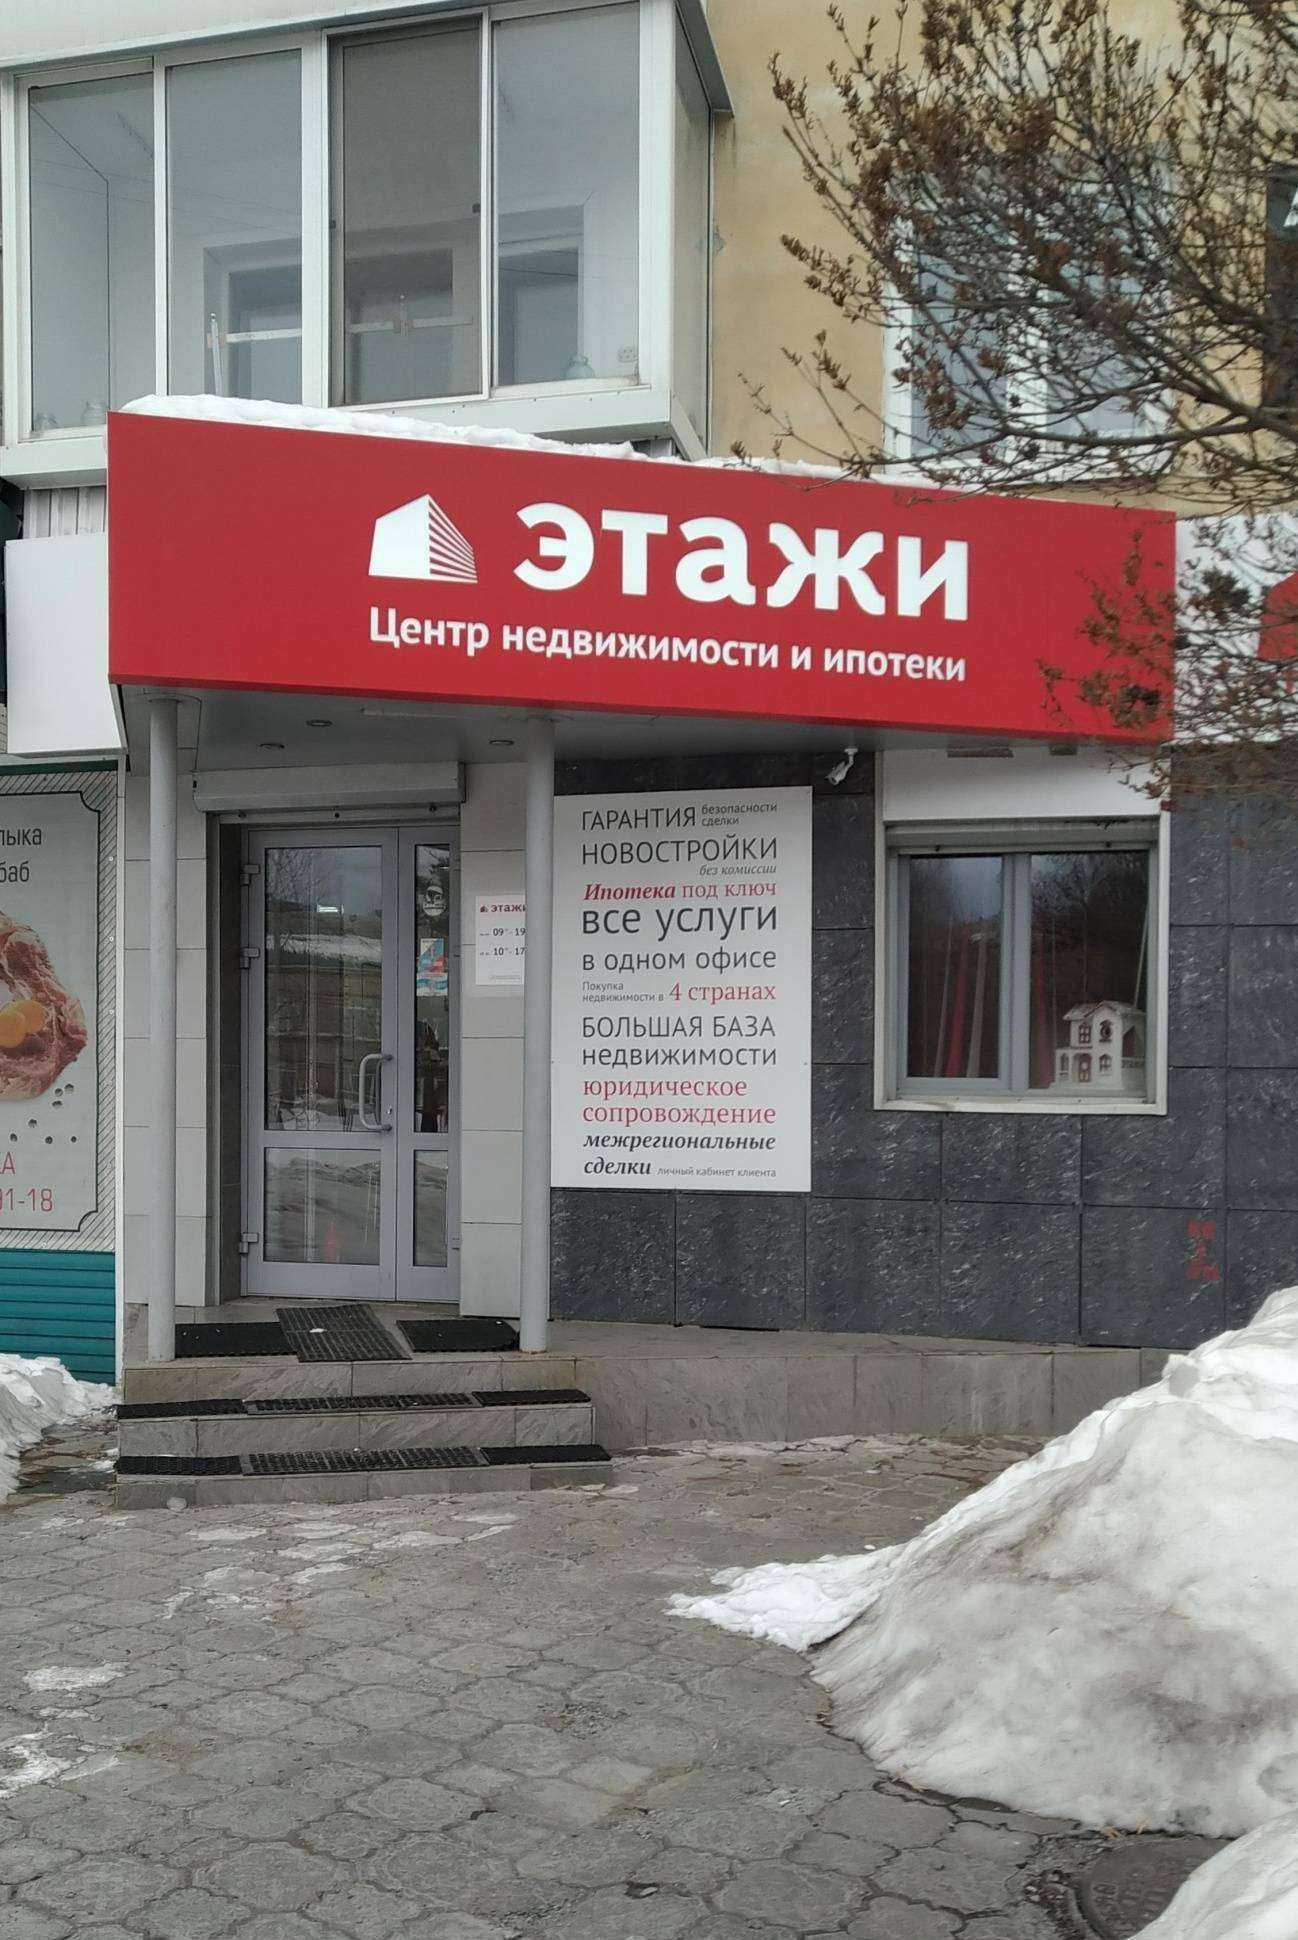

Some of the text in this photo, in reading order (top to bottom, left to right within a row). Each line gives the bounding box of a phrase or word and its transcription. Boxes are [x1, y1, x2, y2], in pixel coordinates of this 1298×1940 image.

[371, 607, 964, 681] Центр недвижимости и ипотеки
[583, 807, 695, 830] ГАРАНТИЯ
[701, 802, 778, 815] безопасности
[700, 815, 739, 827] сделки
[582, 833, 777, 865] НОВОСТРОЙКИ
[700, 865, 776, 876] без комиссии
[584, 883, 776, 900] Ипотека под ключ
[583, 906, 776, 942] все услуги
[583, 946, 776, 974] в одном офисе
[583, 981, 624, 993] Покупка
[669, 983, 776, 1005] 4 странах
[582, 993, 655, 1003] недвижимости
[583, 1016, 775, 1037] БОЛЬШАЯ БАЗА
[583, 1048, 776, 1069] недвижимости
[584, 1080, 747, 1101] юридическое
[583, 1105, 776, 1128] сопровождение
[583, 1135, 775, 1152] межрегиональные
[584, 1157, 776, 1177] сделки личный кабинет клиента
[0, 1188, 52, 1212] 1-18
